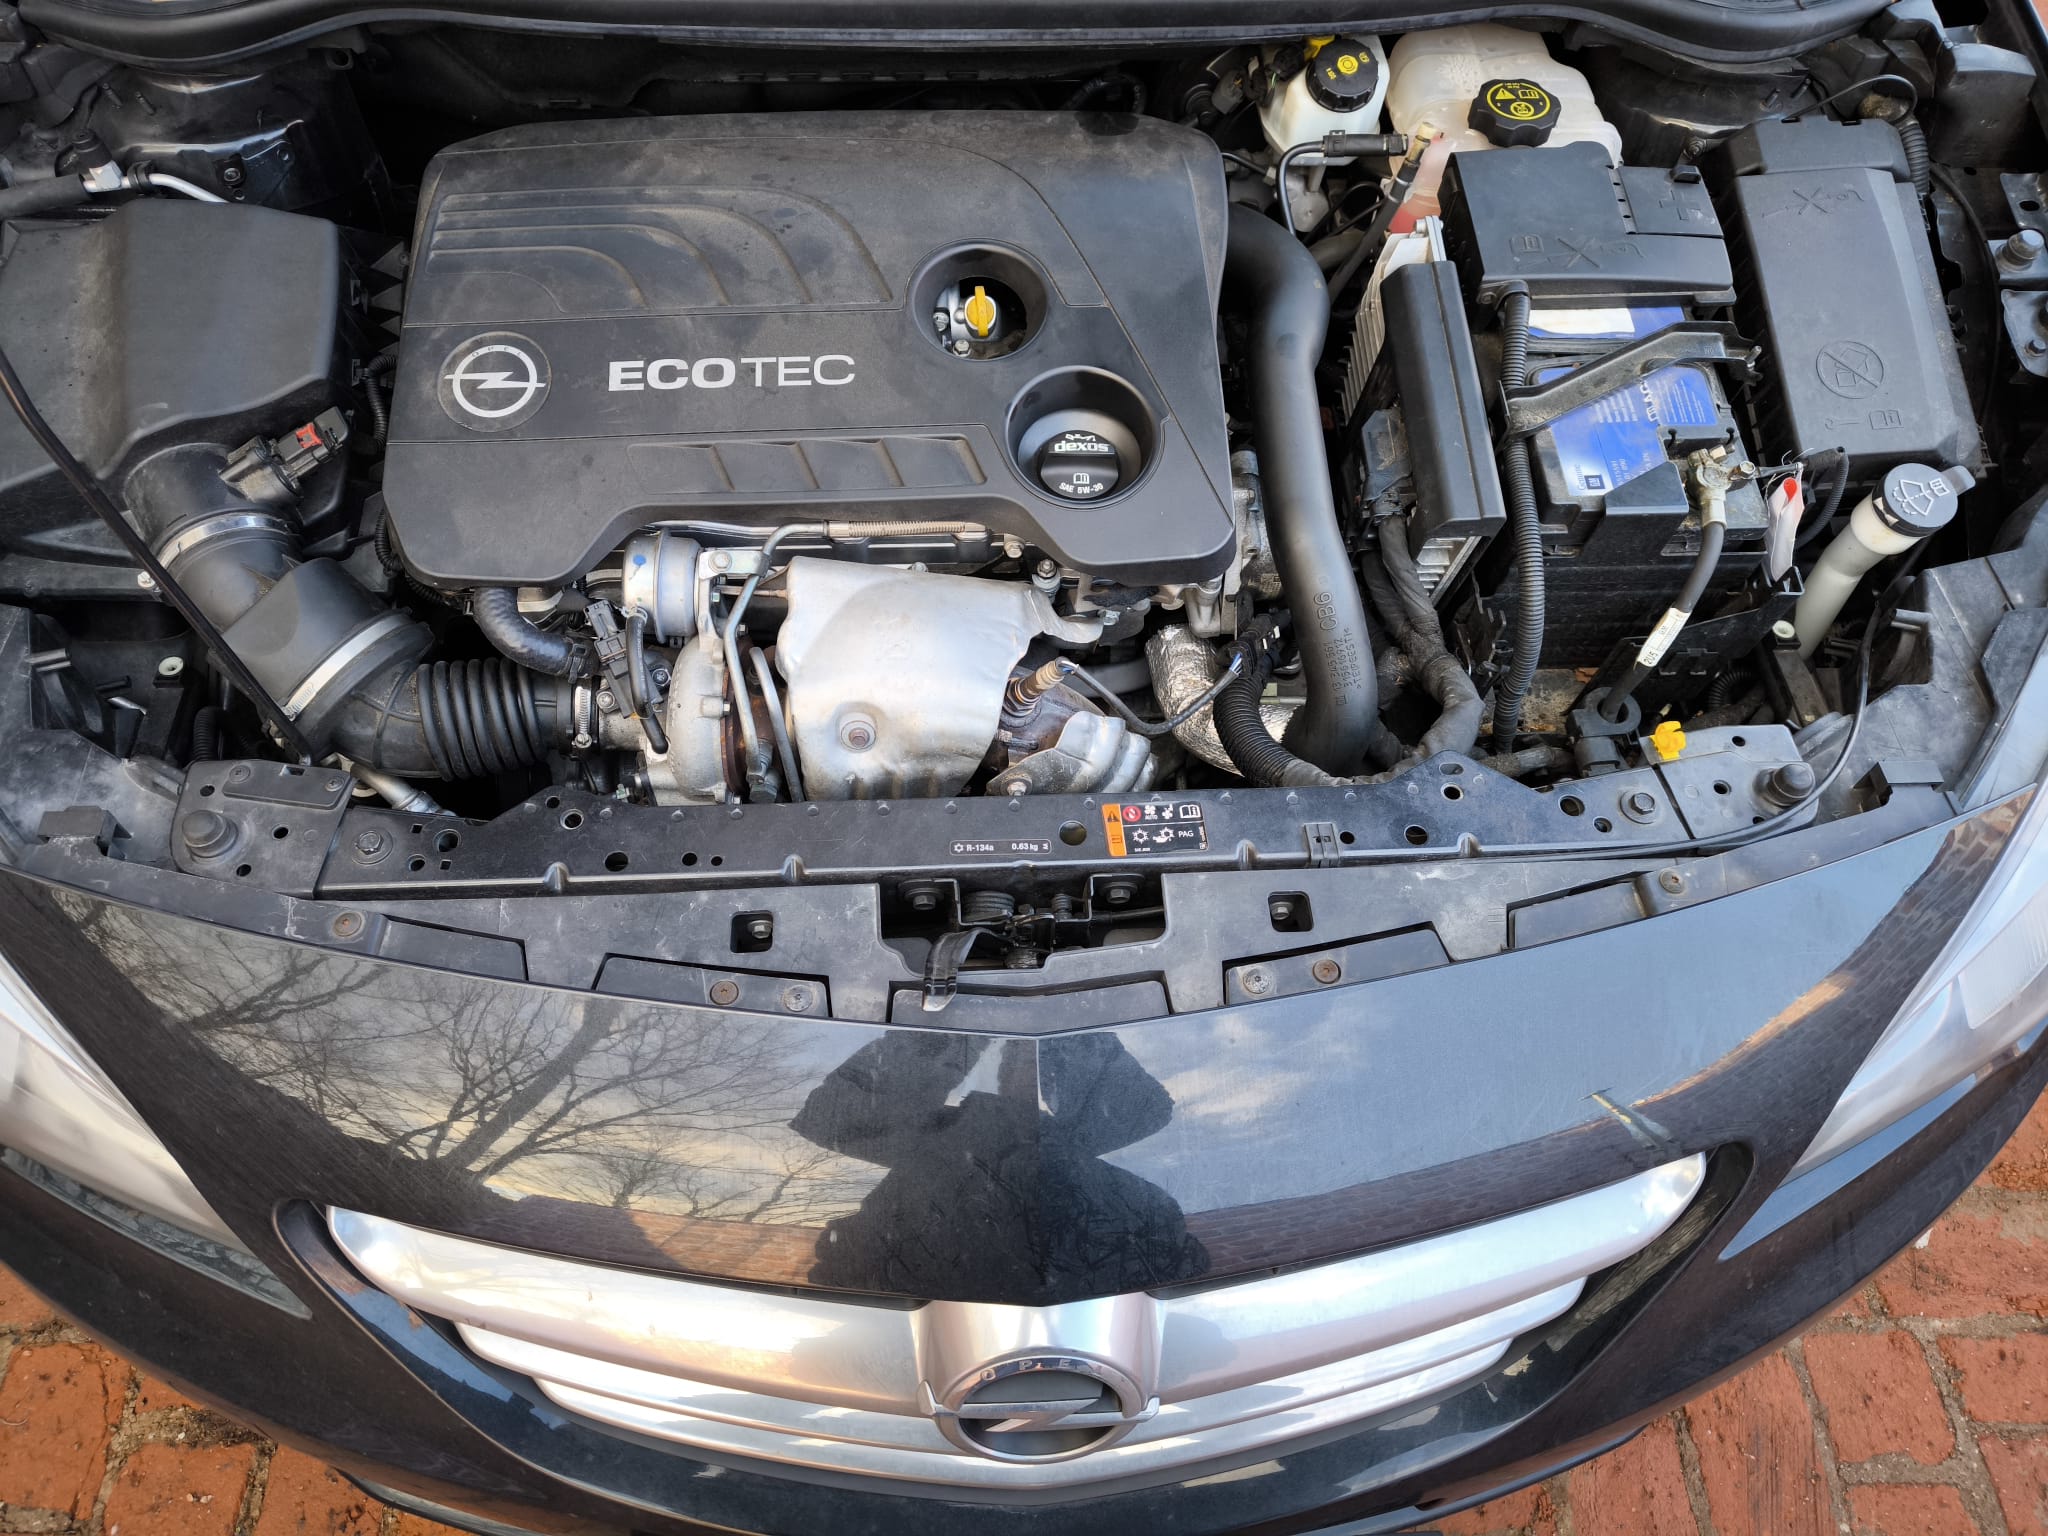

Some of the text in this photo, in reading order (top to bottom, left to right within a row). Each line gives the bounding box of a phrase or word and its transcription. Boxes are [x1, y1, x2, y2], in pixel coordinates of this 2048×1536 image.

[608, 354, 856, 392] ECOTEC
[1054, 440, 1109, 453] dexos
[1059, 482, 1075, 493] SAE
[1314, 592, 1338, 631] CB6
[966, 844, 994, 852] R-134a
[1011, 842, 1029, 851] 0.63
